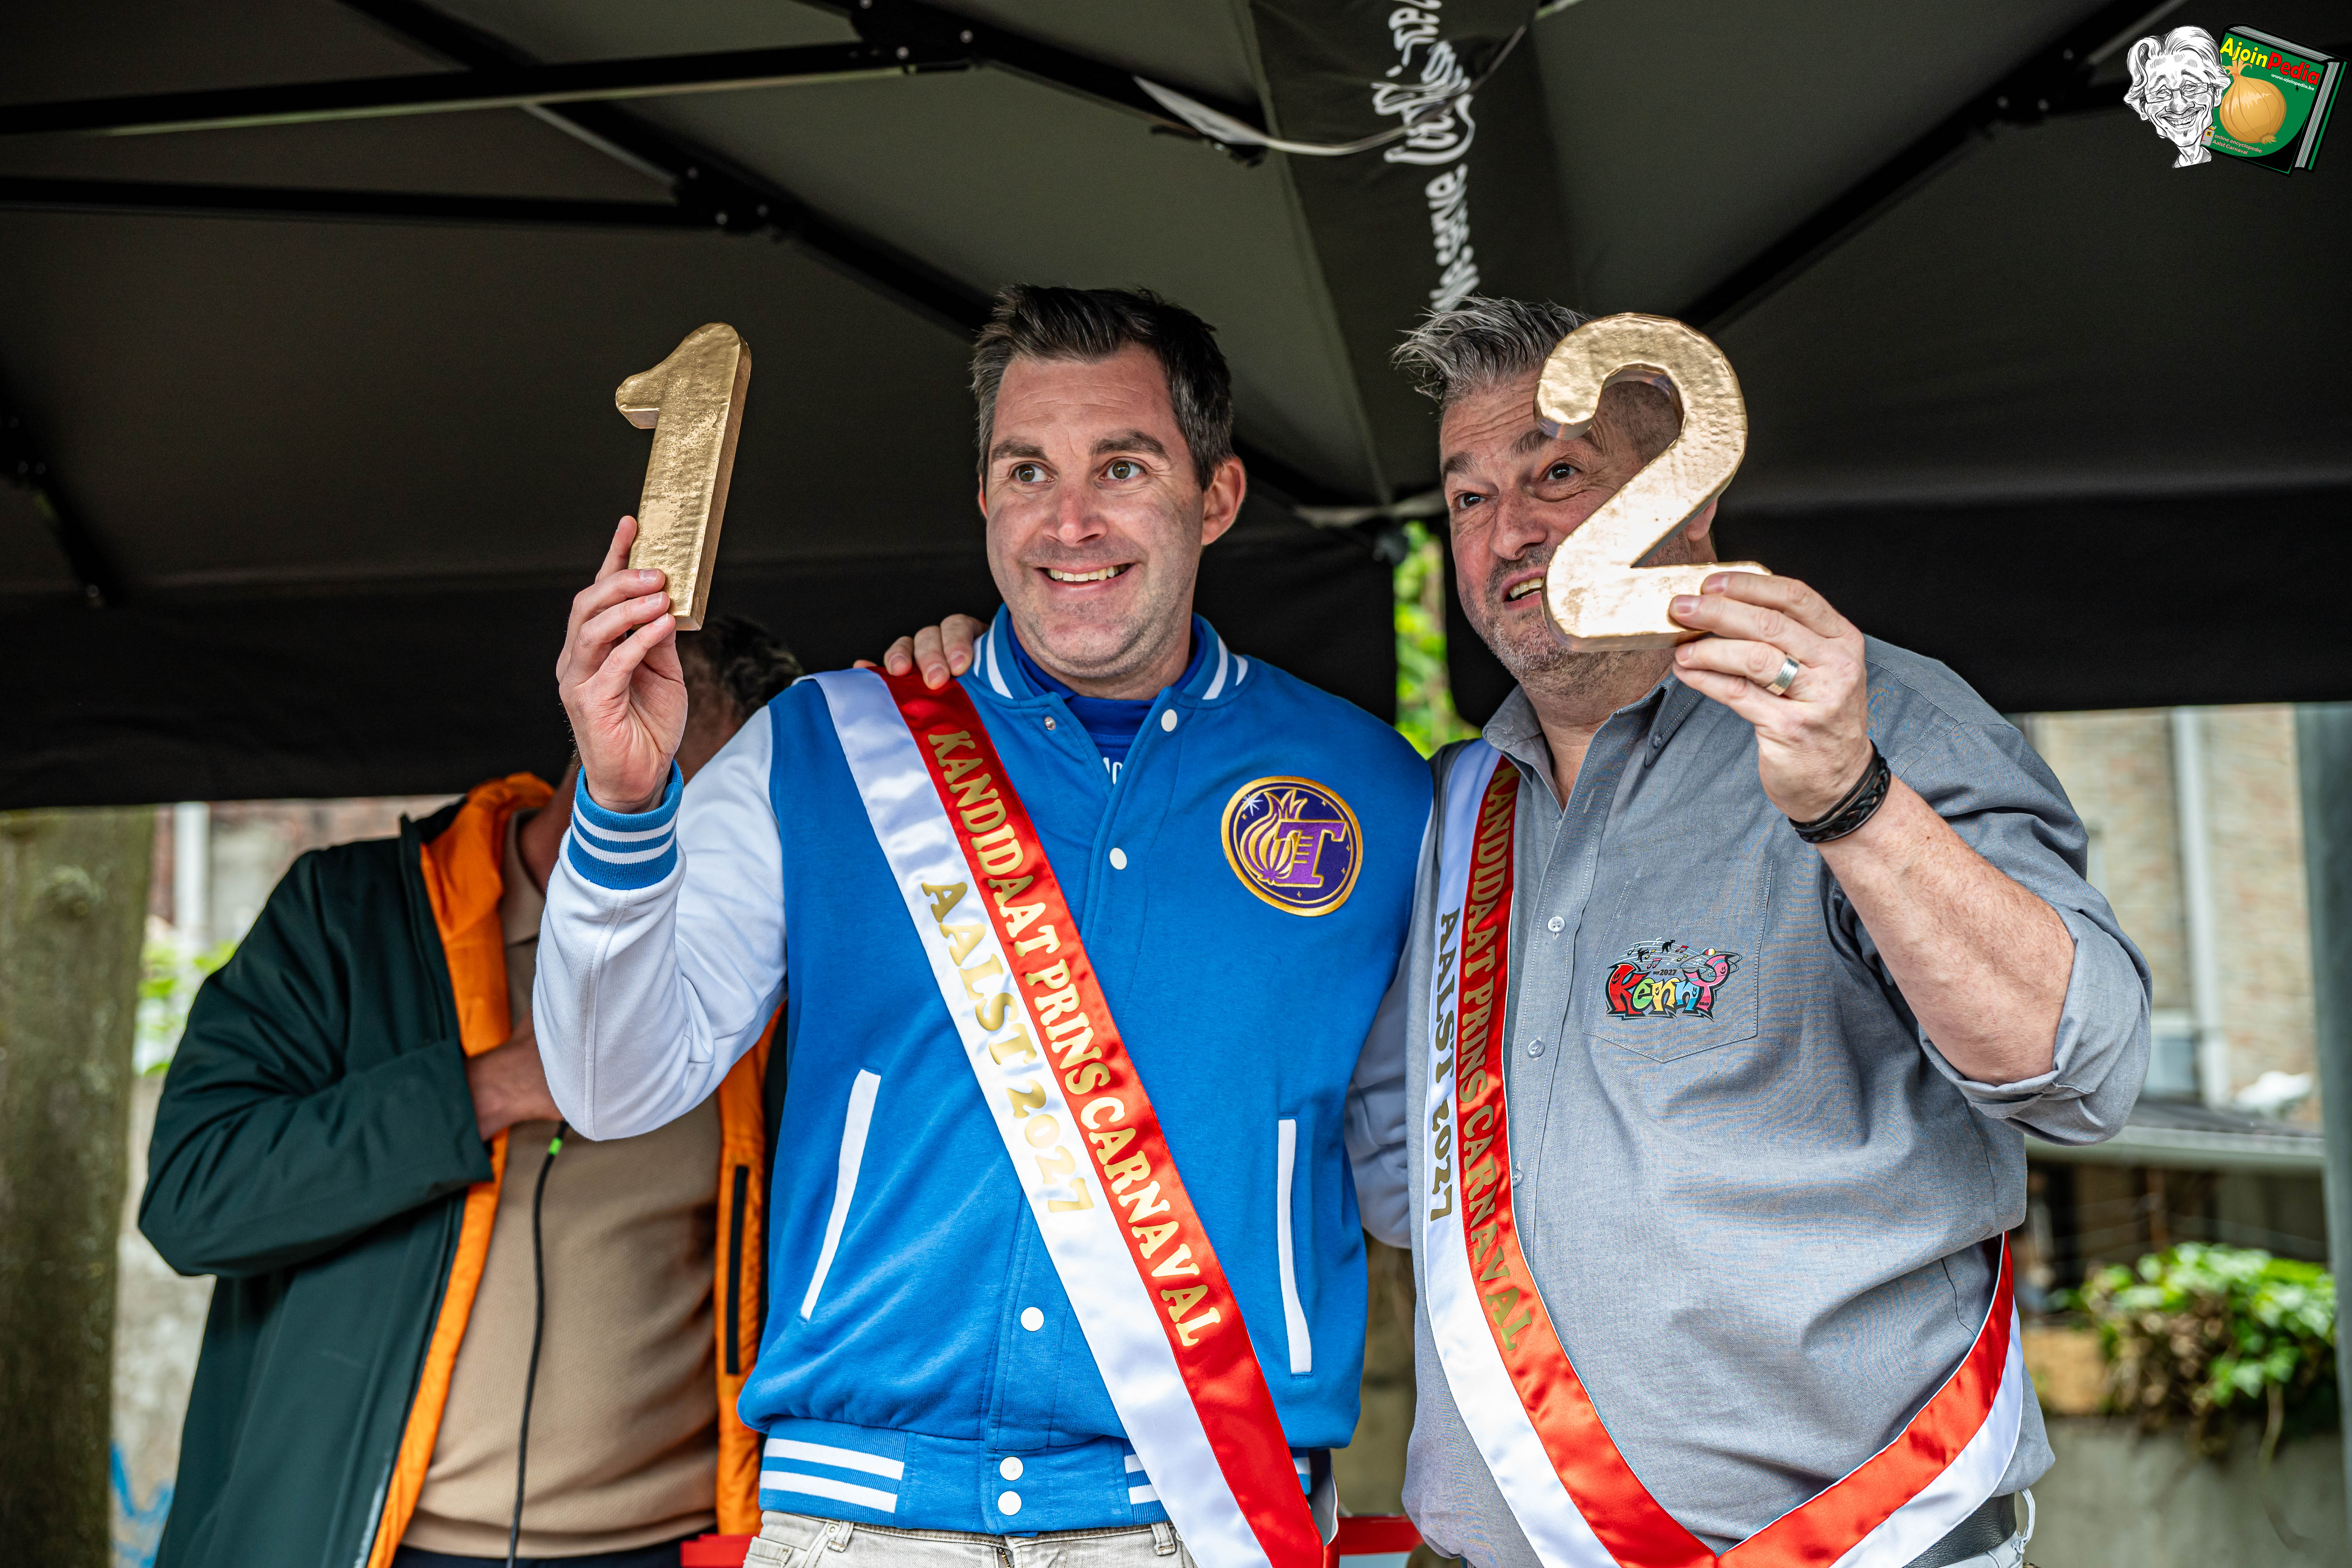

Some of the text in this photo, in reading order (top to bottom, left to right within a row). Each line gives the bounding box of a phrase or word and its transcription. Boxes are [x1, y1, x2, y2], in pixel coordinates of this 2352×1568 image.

[616, 322, 751, 630] 1
[1533, 312, 1773, 652] 2
[921, 882, 1094, 1213] AALST 2027
[928, 730, 1222, 1346] KANDIDAAT PRINS CARNAVAL
[1430, 907, 1460, 1222] AALST 2027
[1459, 976, 1494, 1102] PRINS
[1463, 1105, 1532, 1351] CARNAVAL
